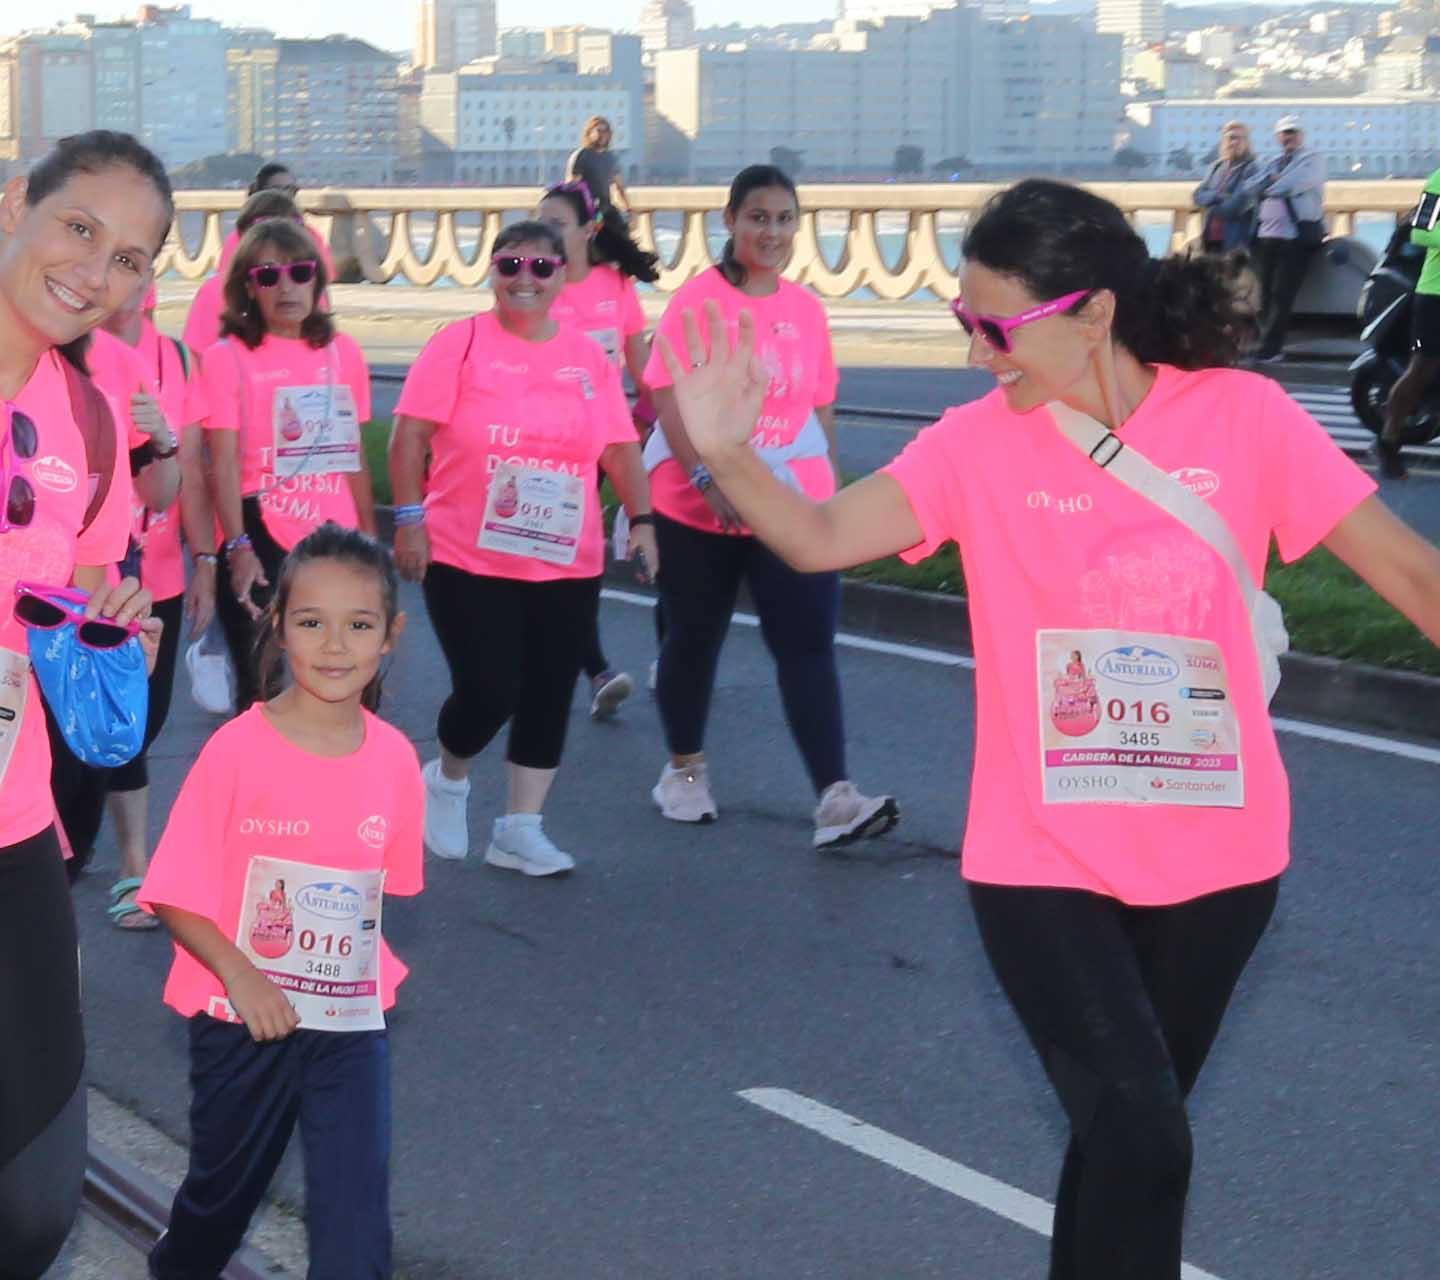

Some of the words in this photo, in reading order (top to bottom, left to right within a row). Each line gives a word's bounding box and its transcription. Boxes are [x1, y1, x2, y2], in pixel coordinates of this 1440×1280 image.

[487, 423, 520, 447] TU
[1026, 490, 1094, 513] OYHO
[520, 502, 553, 520] 016
[1103, 658, 1174, 677] ASTURIANA
[1106, 698, 1171, 725] 016
[1119, 731, 1161, 746] 3485
[1062, 753, 1117, 763] CARRERA
[1118, 753, 1135, 764] DE
[1135, 754, 1151, 764] LA
[1153, 754, 1192, 766] MUJER
[1057, 775, 1118, 790] OYSHO
[1165, 778, 1227, 793] Santander
[239, 817, 311, 836] OYSHO
[298, 929, 353, 957] 016
[304, 960, 342, 978] 3488
[300, 981, 316, 992] DE
[316, 982, 330, 993] LA
